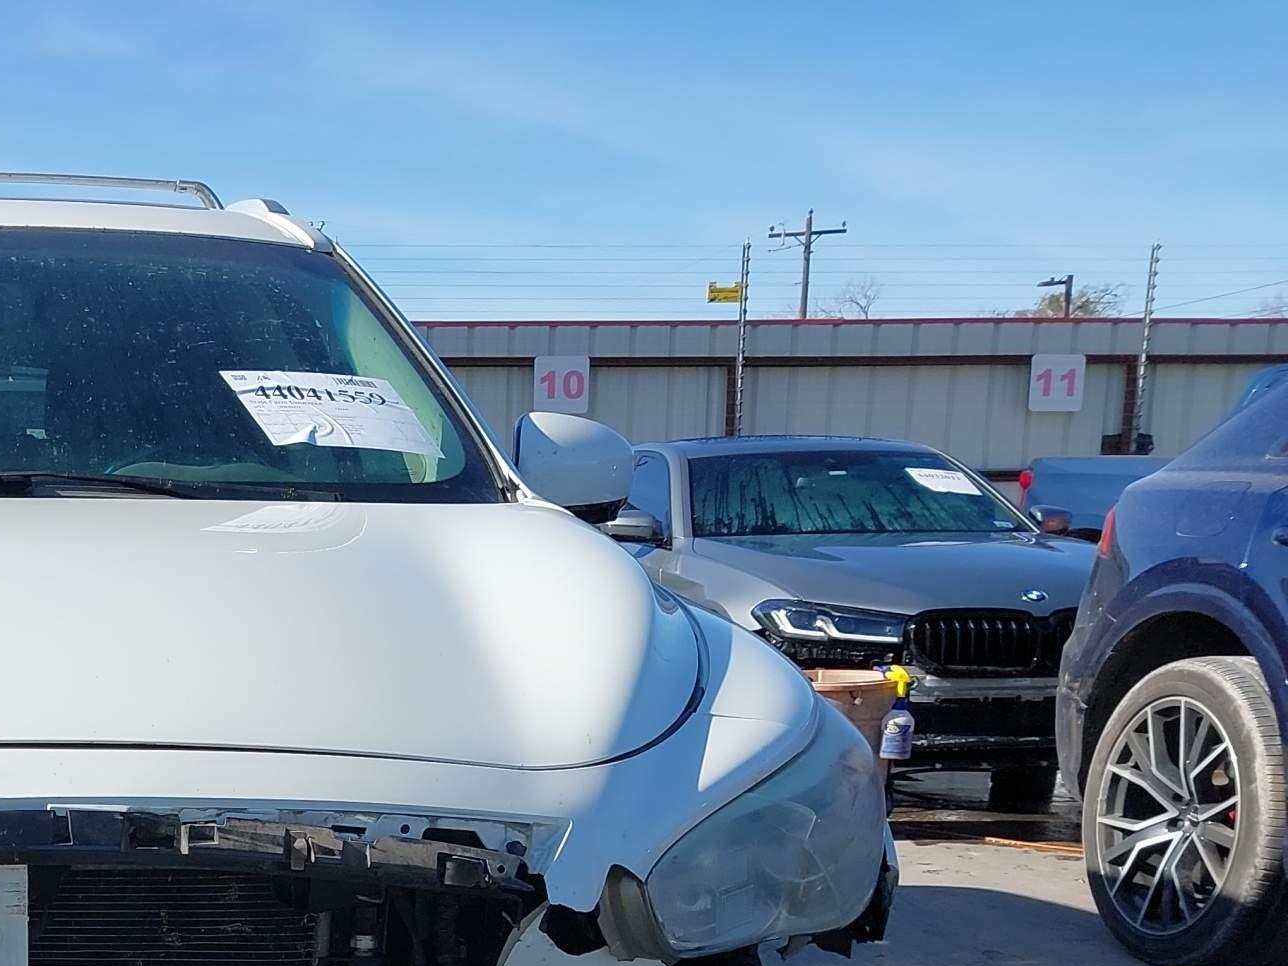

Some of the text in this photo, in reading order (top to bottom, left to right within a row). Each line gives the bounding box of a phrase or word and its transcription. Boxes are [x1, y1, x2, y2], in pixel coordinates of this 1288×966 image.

[254, 385, 387, 406] 44041559
[539, 369, 586, 400] 10
[1036, 367, 1078, 398] 11
